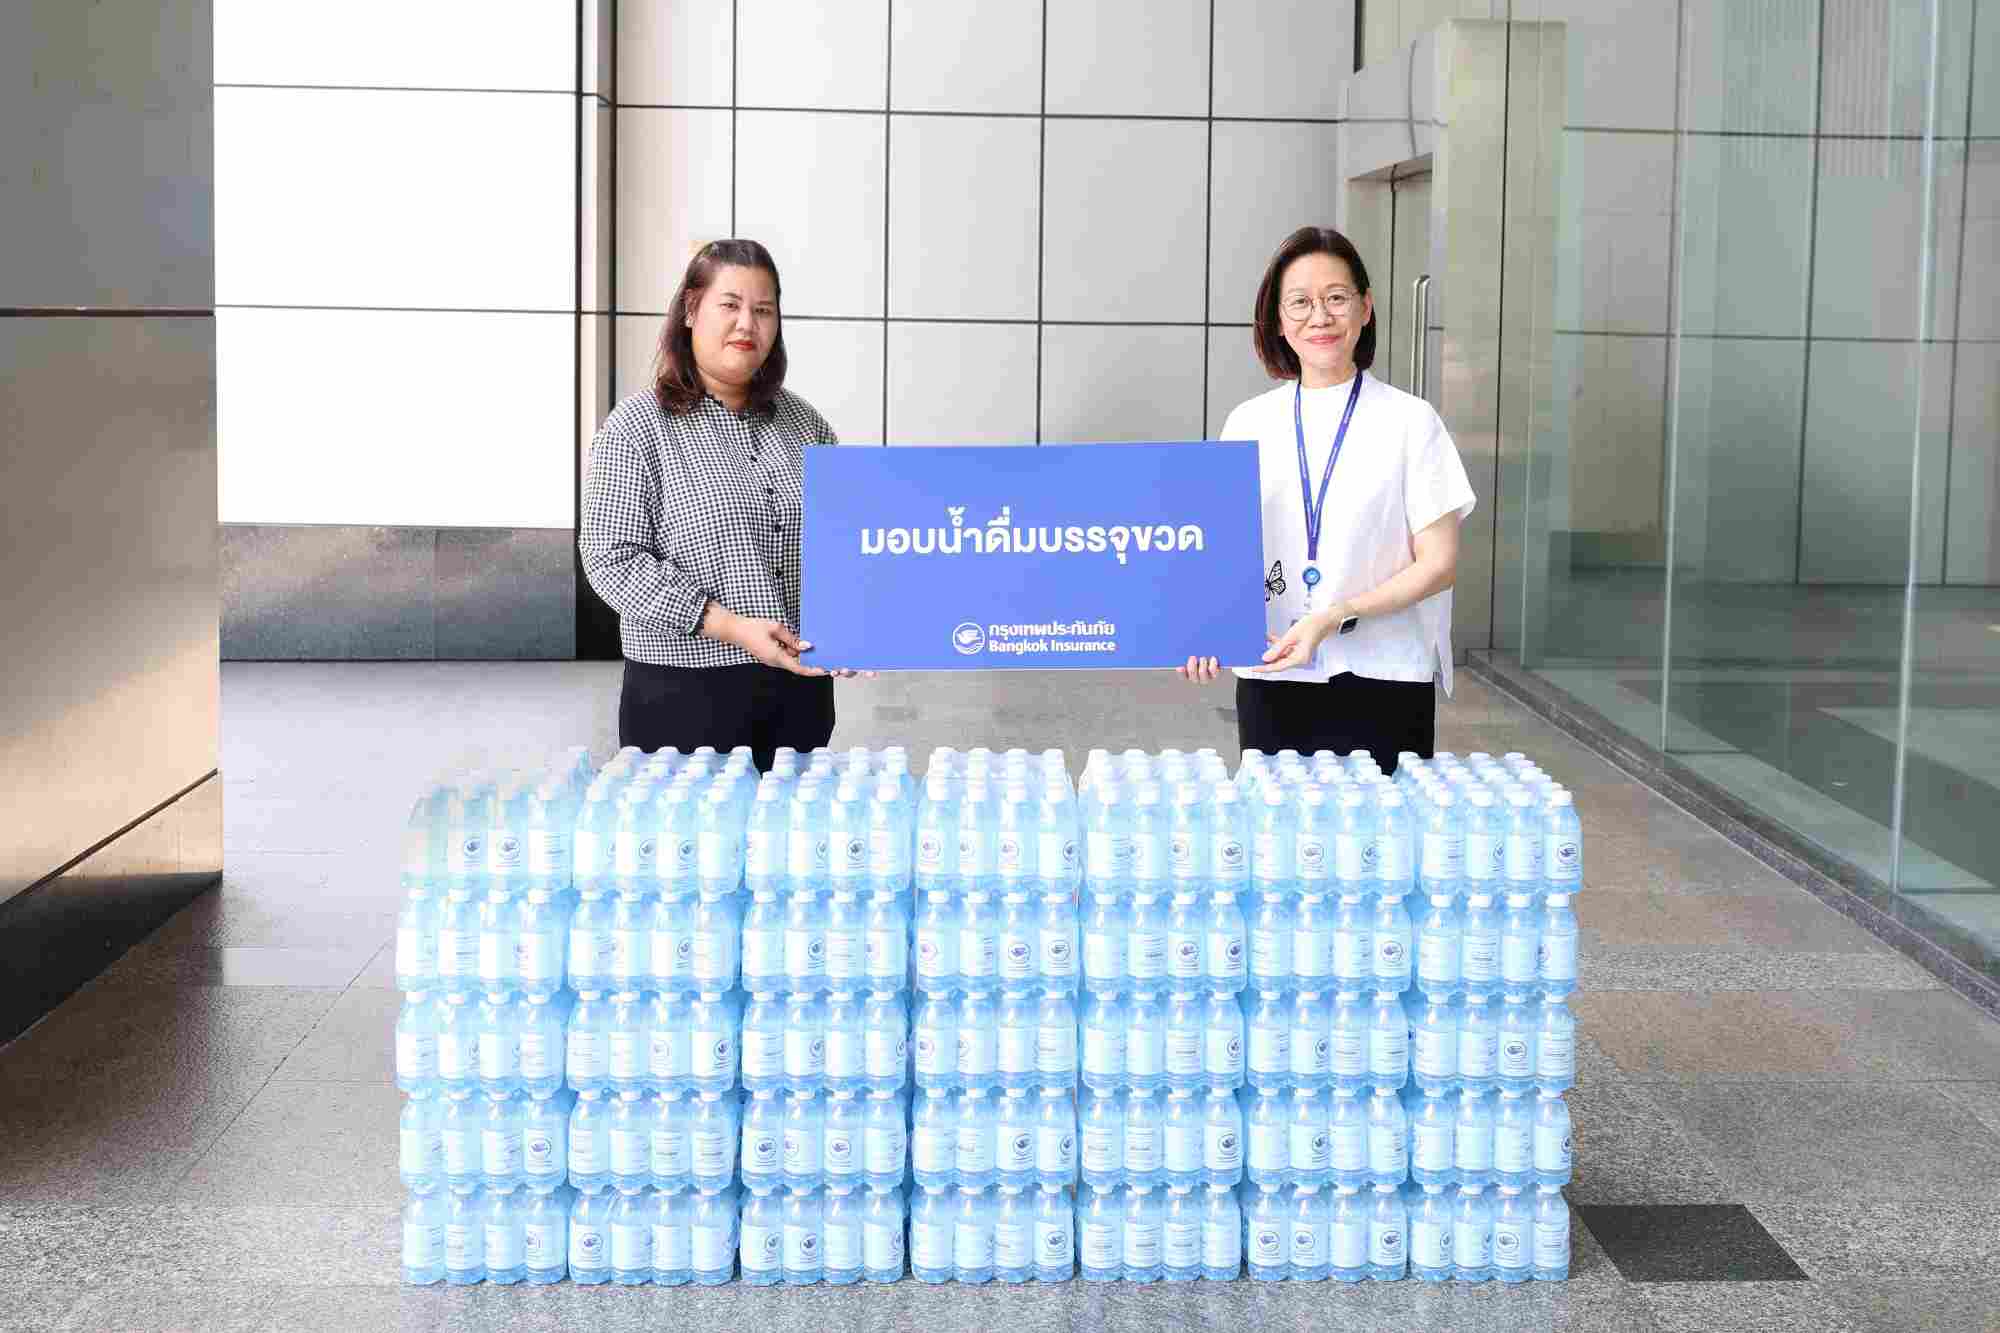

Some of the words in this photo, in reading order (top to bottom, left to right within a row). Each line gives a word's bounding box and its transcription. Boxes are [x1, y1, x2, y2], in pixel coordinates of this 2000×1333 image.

[860, 506, 1204, 565] มอบน้ำดื่มบรรจุขวด
[988, 620, 1116, 640] กรุงเทพประกันภัย
[988, 639, 1049, 655] Bangkok
[1051, 639, 1116, 652] Insurance
